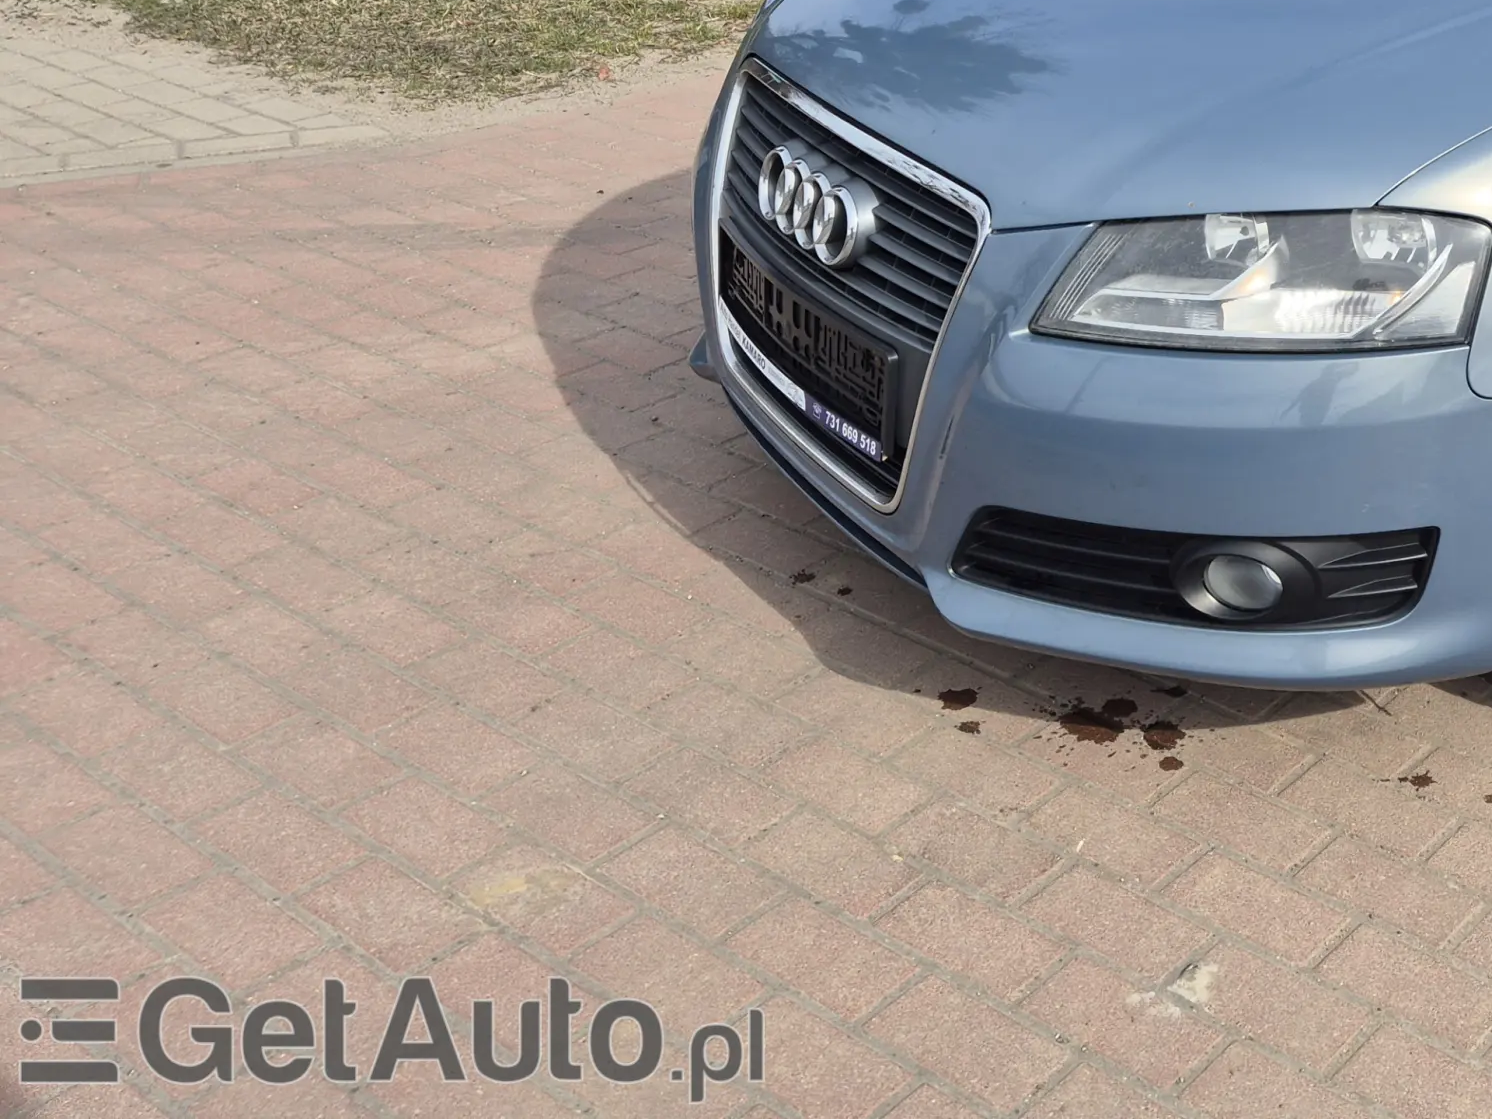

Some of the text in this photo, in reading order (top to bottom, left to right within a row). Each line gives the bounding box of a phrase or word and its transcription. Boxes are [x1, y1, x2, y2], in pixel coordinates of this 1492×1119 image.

[825, 410, 840, 432] 731
[842, 422, 858, 444] 669
[860, 434, 877, 455] 518
